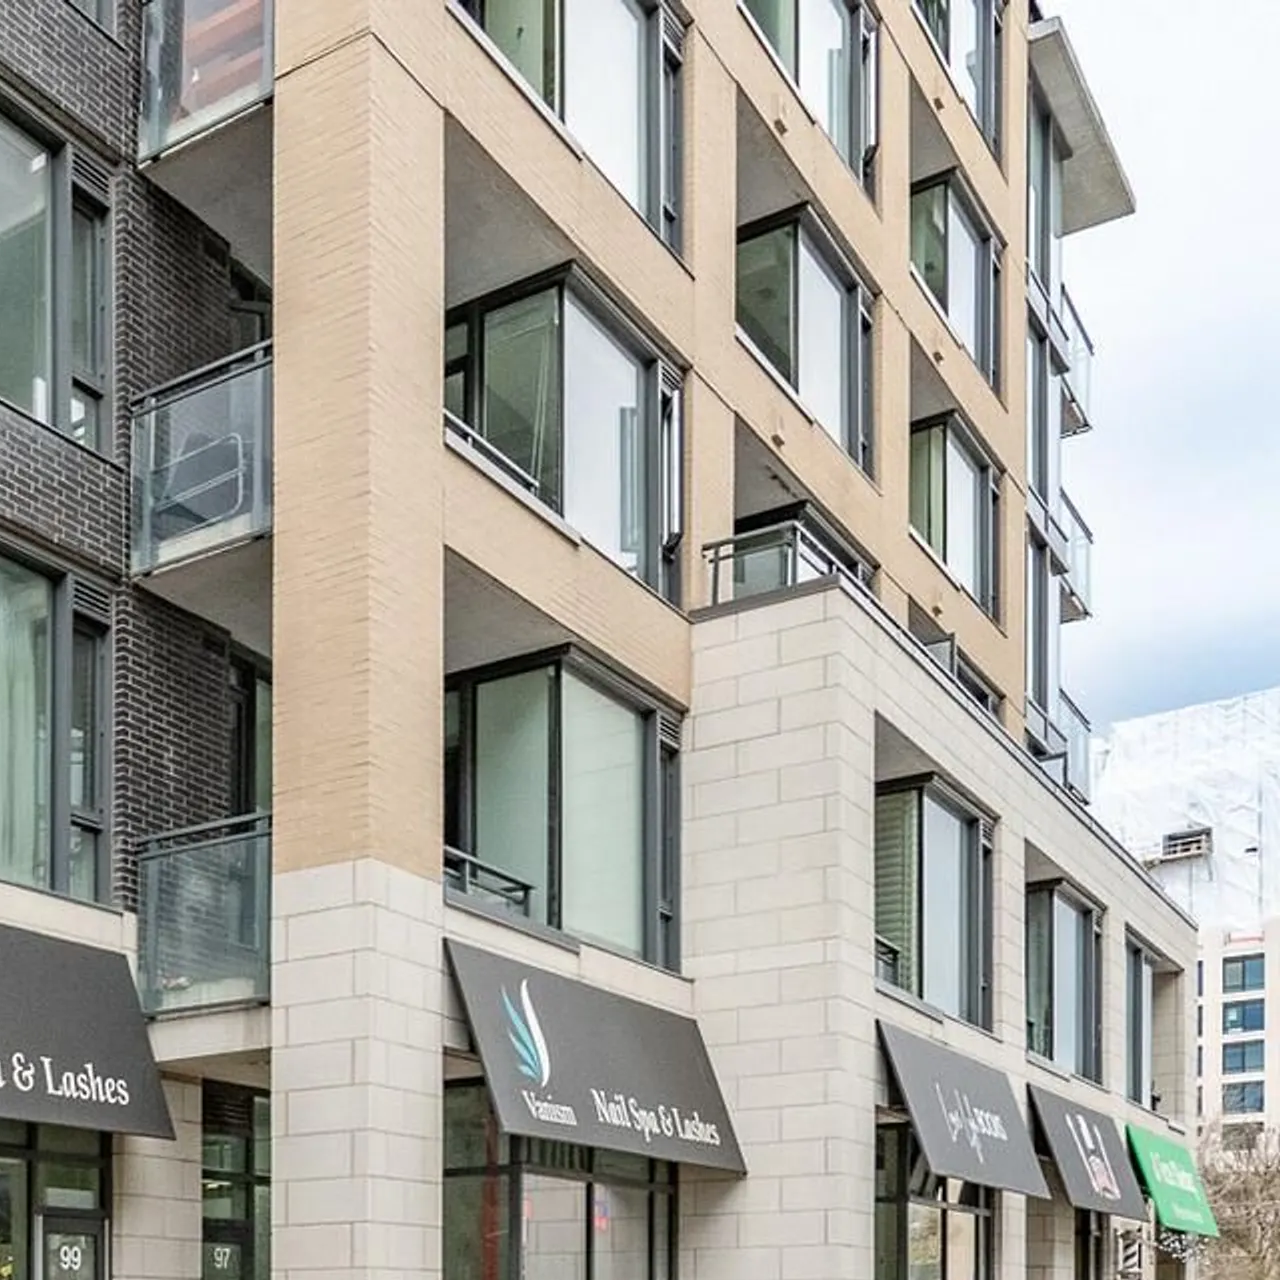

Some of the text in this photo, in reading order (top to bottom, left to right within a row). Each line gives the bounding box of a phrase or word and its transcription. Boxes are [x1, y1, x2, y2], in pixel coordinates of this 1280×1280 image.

[12, 1052, 35, 1091] &
[40, 1056, 130, 1105] Lashes
[522, 1089, 578, 1126] Vanism
[590, 1088, 720, 1145] Nail Spa & Lashes
[60, 1246, 82, 1270] 99
[213, 1247, 231, 1269] 97
